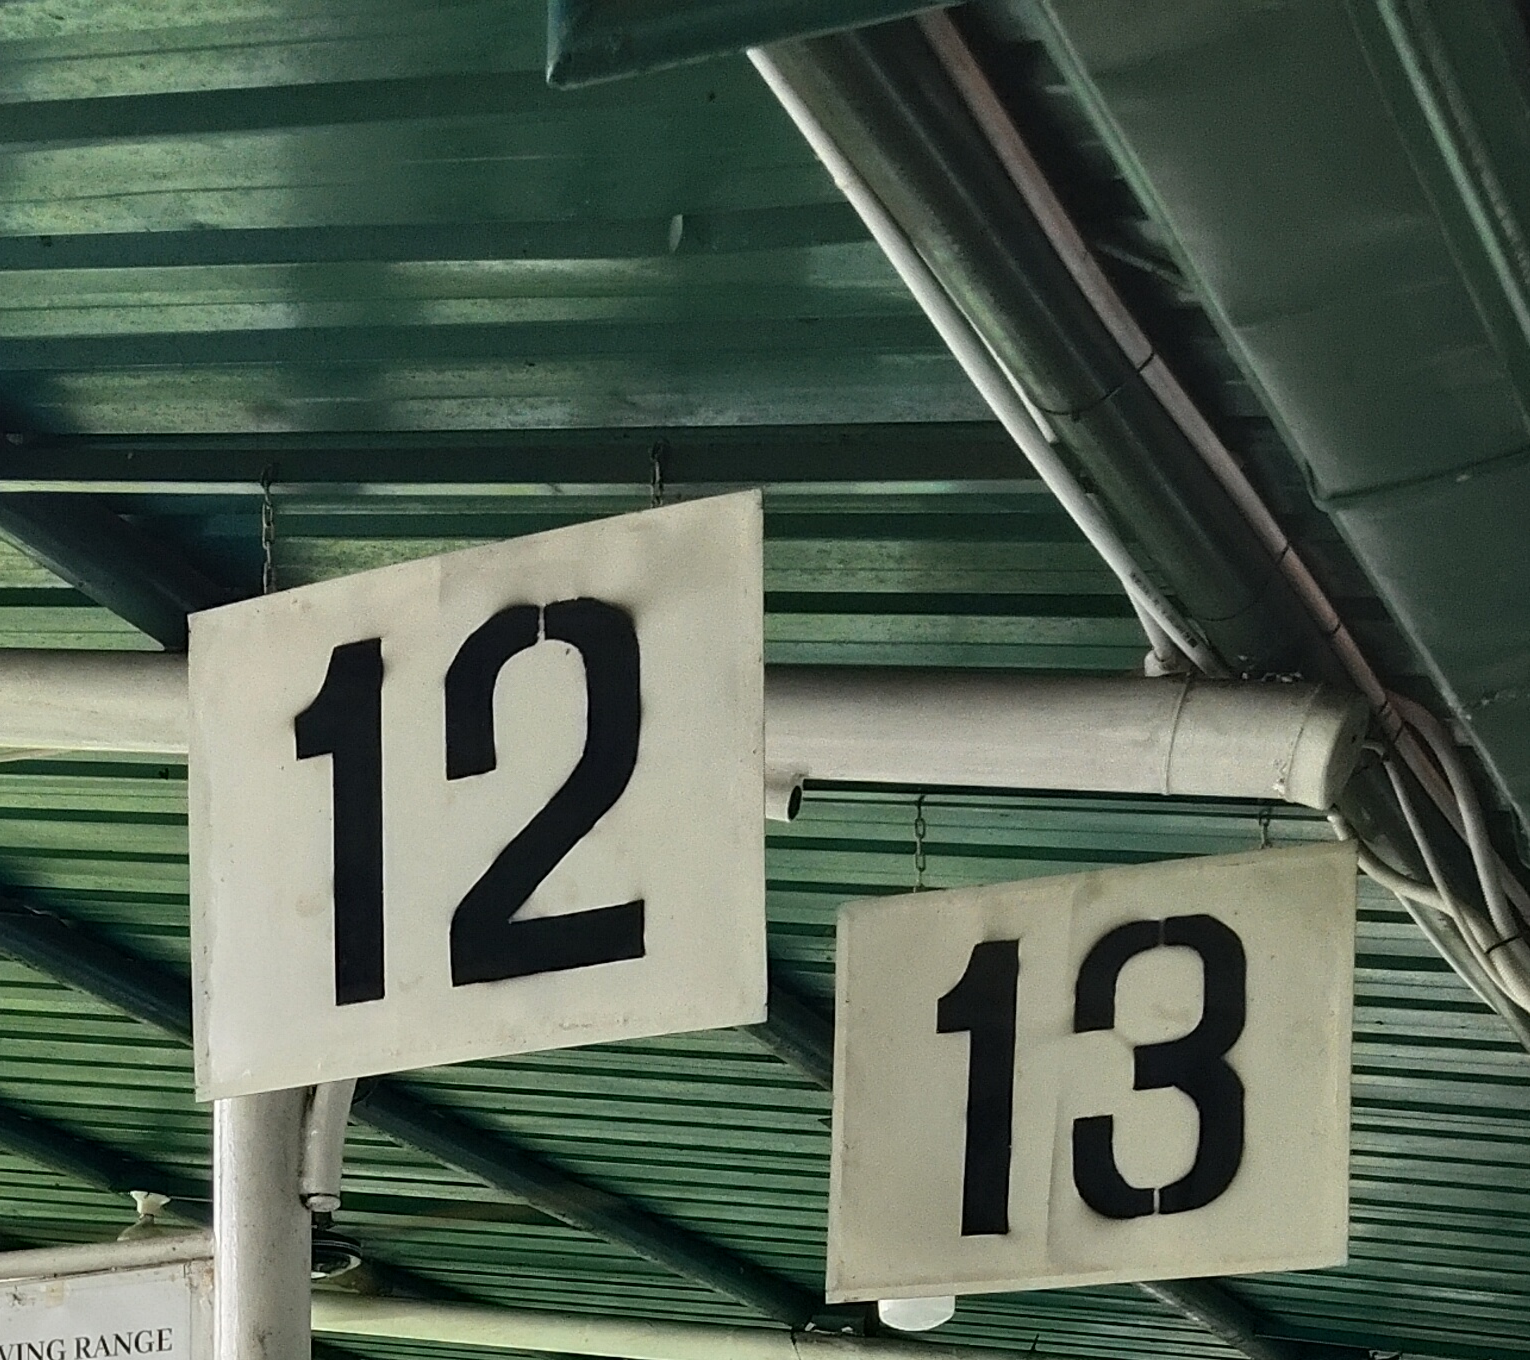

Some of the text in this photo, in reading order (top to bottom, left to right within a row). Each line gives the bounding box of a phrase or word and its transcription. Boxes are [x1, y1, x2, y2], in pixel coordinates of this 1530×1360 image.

[293, 597, 646, 1005] 12
[936, 913, 1247, 1236] 13
[74, 1328, 173, 1360] RANGE
